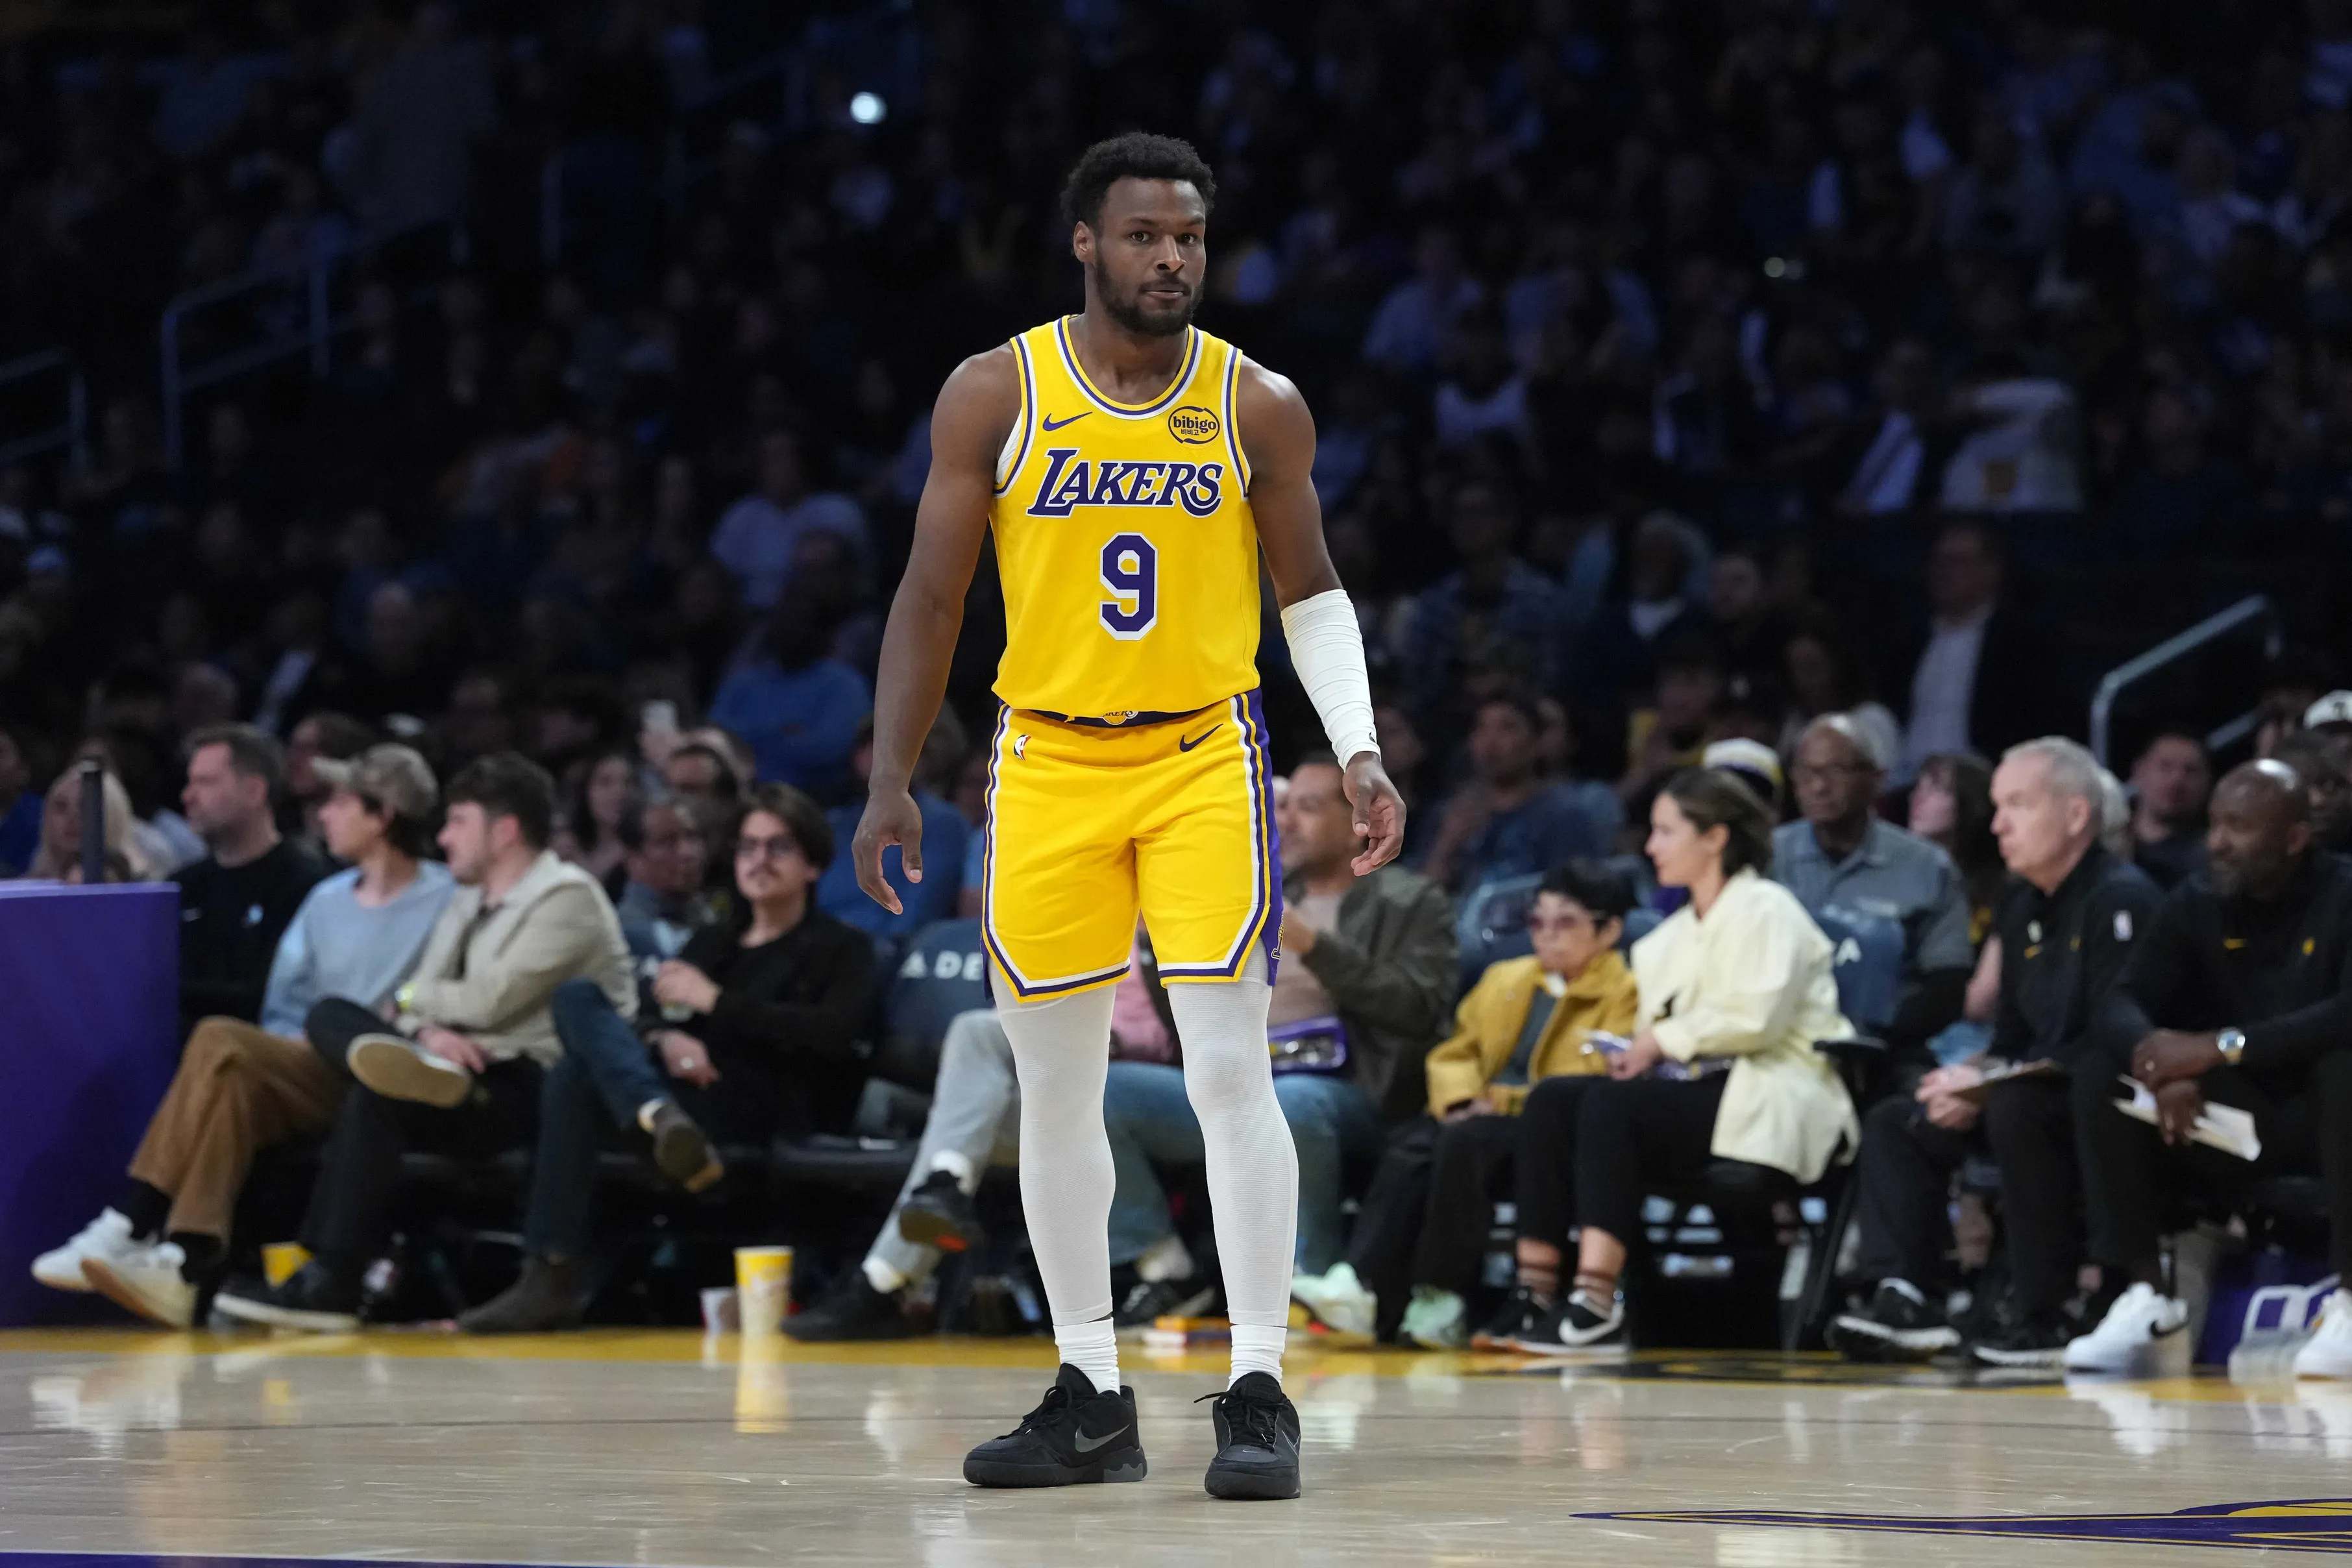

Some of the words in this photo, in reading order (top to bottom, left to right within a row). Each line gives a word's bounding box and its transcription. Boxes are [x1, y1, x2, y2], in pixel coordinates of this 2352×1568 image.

[1173, 415, 1217, 434] bibigo
[1026, 447, 1225, 518] LAKERS
[1099, 532, 1158, 641] 9
